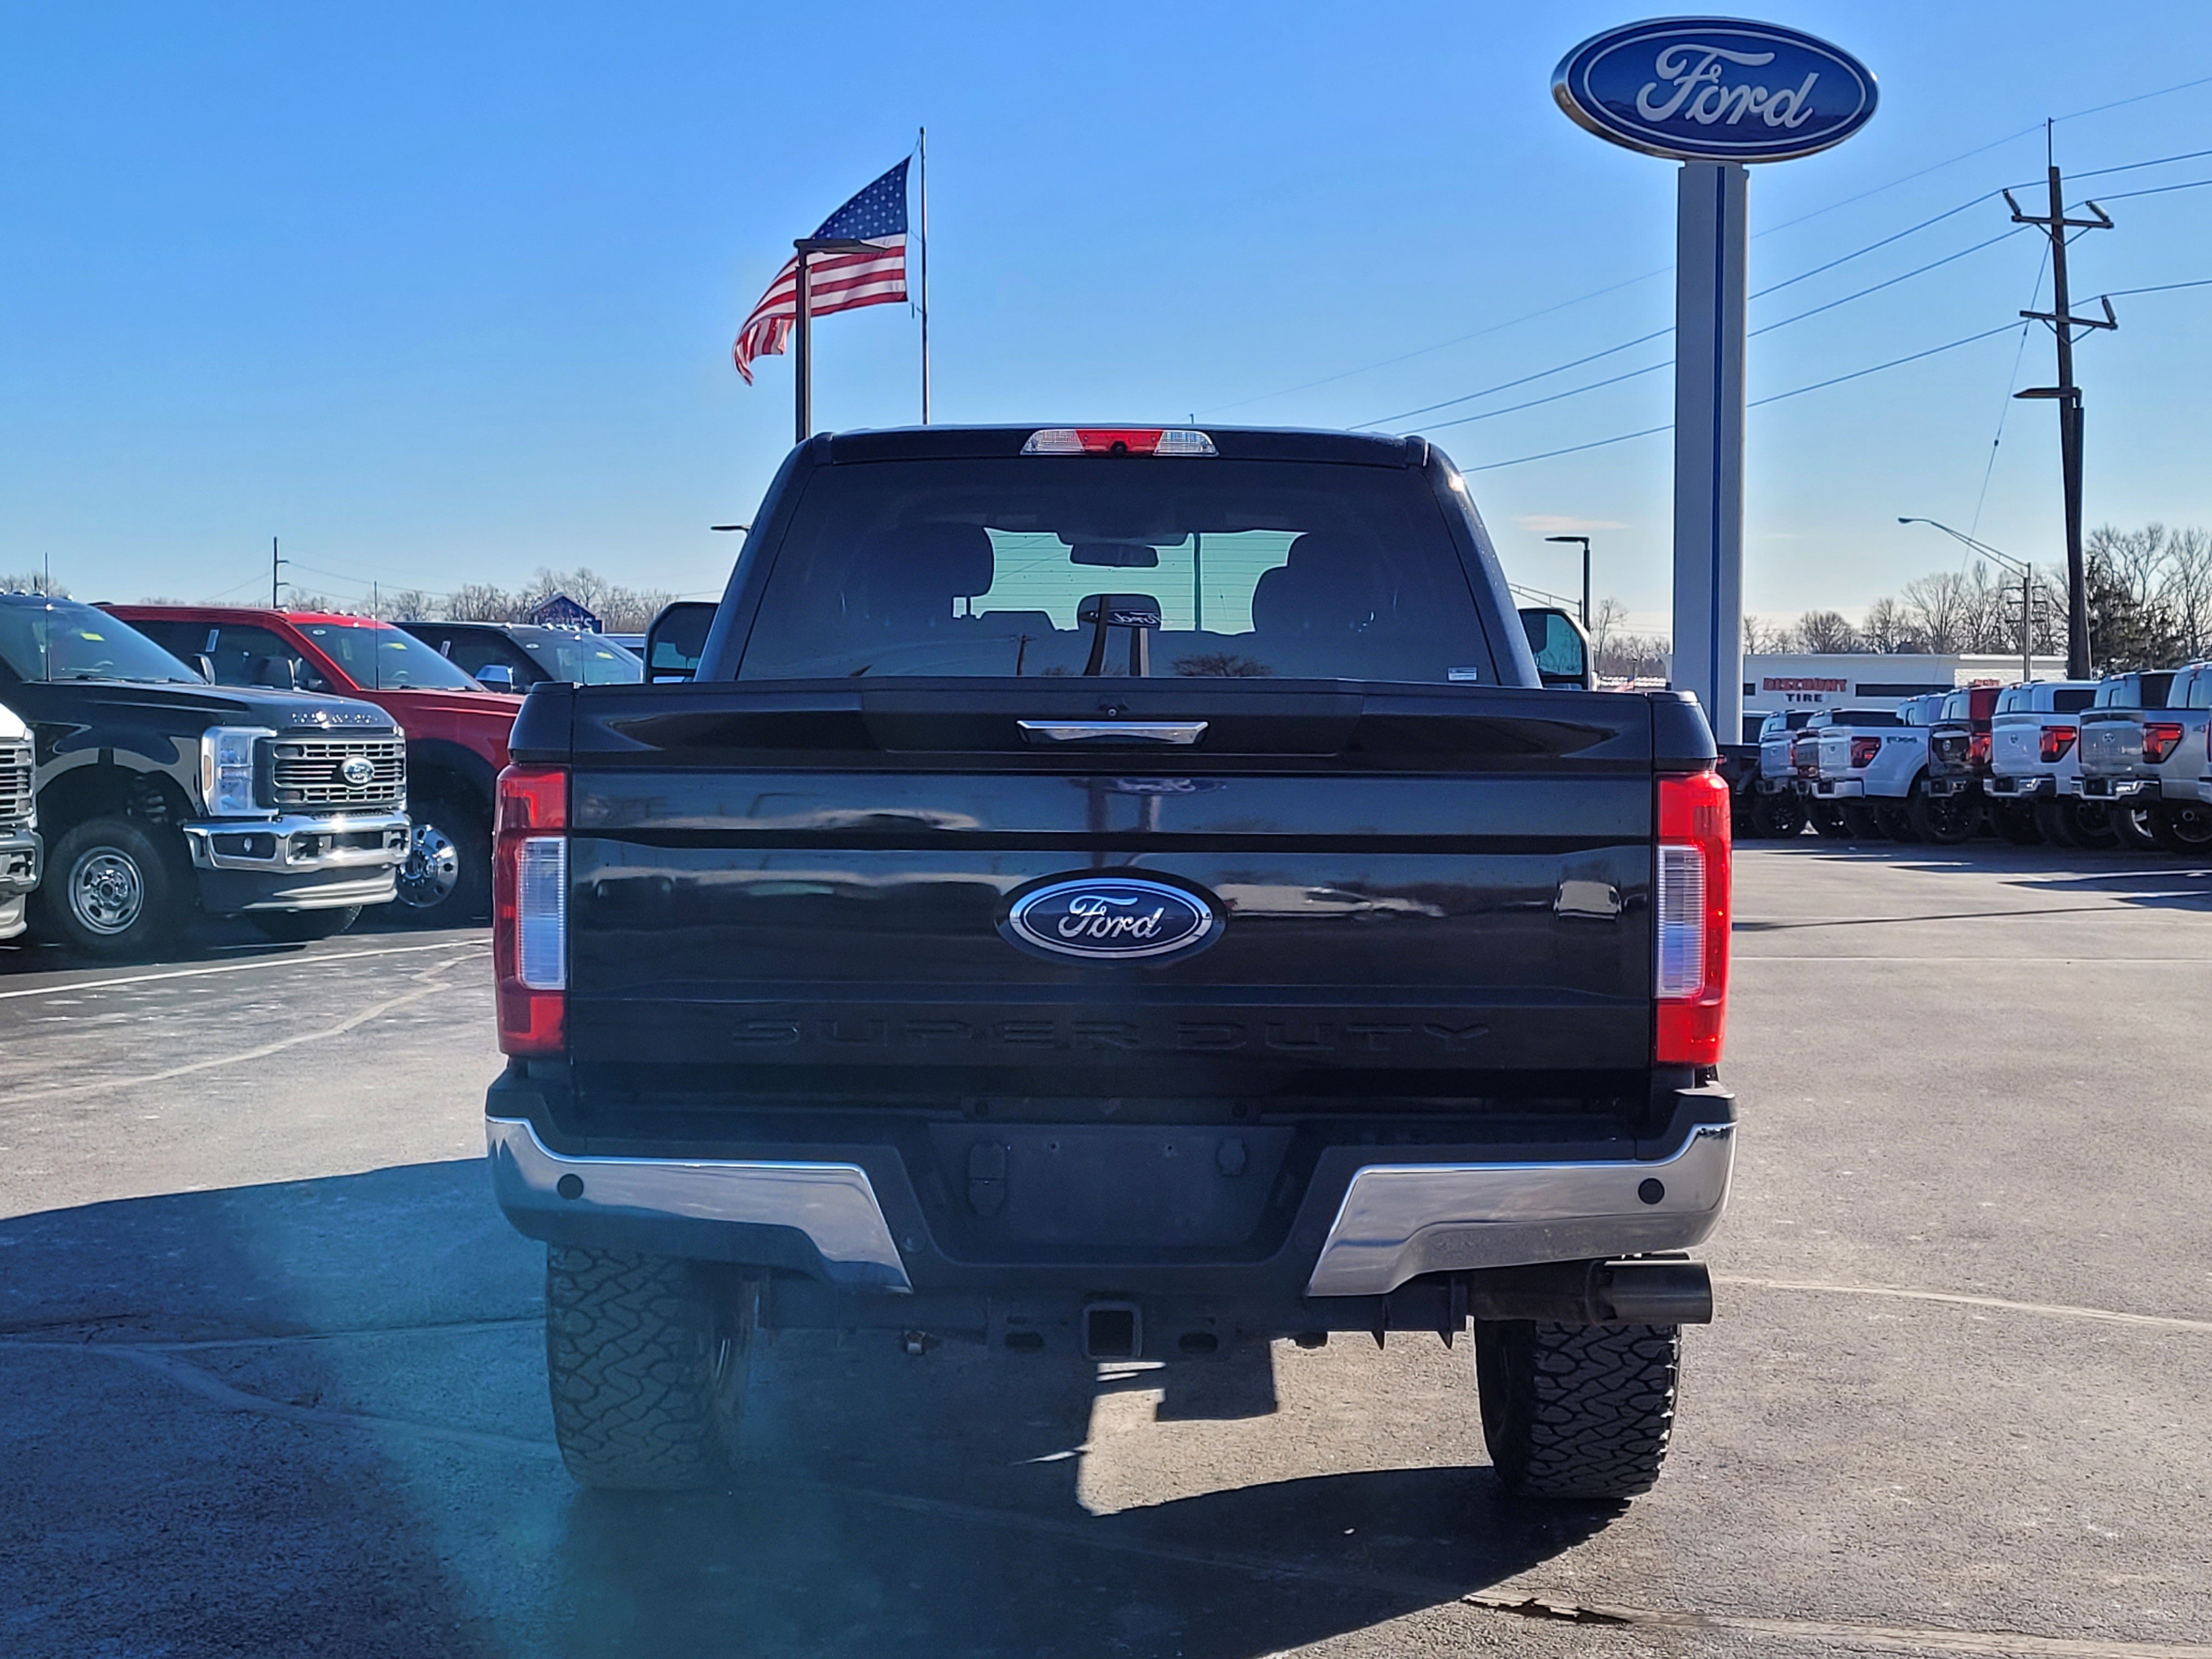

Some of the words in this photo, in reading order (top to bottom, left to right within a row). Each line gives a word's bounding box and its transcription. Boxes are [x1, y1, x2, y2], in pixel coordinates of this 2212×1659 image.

[1636, 43, 1820, 128] Ford
[1763, 678, 1847, 692] DISCOUNT
[1785, 693, 1822, 702] TIRE
[1058, 895, 1165, 939] Ford
[732, 1019, 1140, 1050] SUPER
[1177, 1021, 1489, 1052] DUTY
